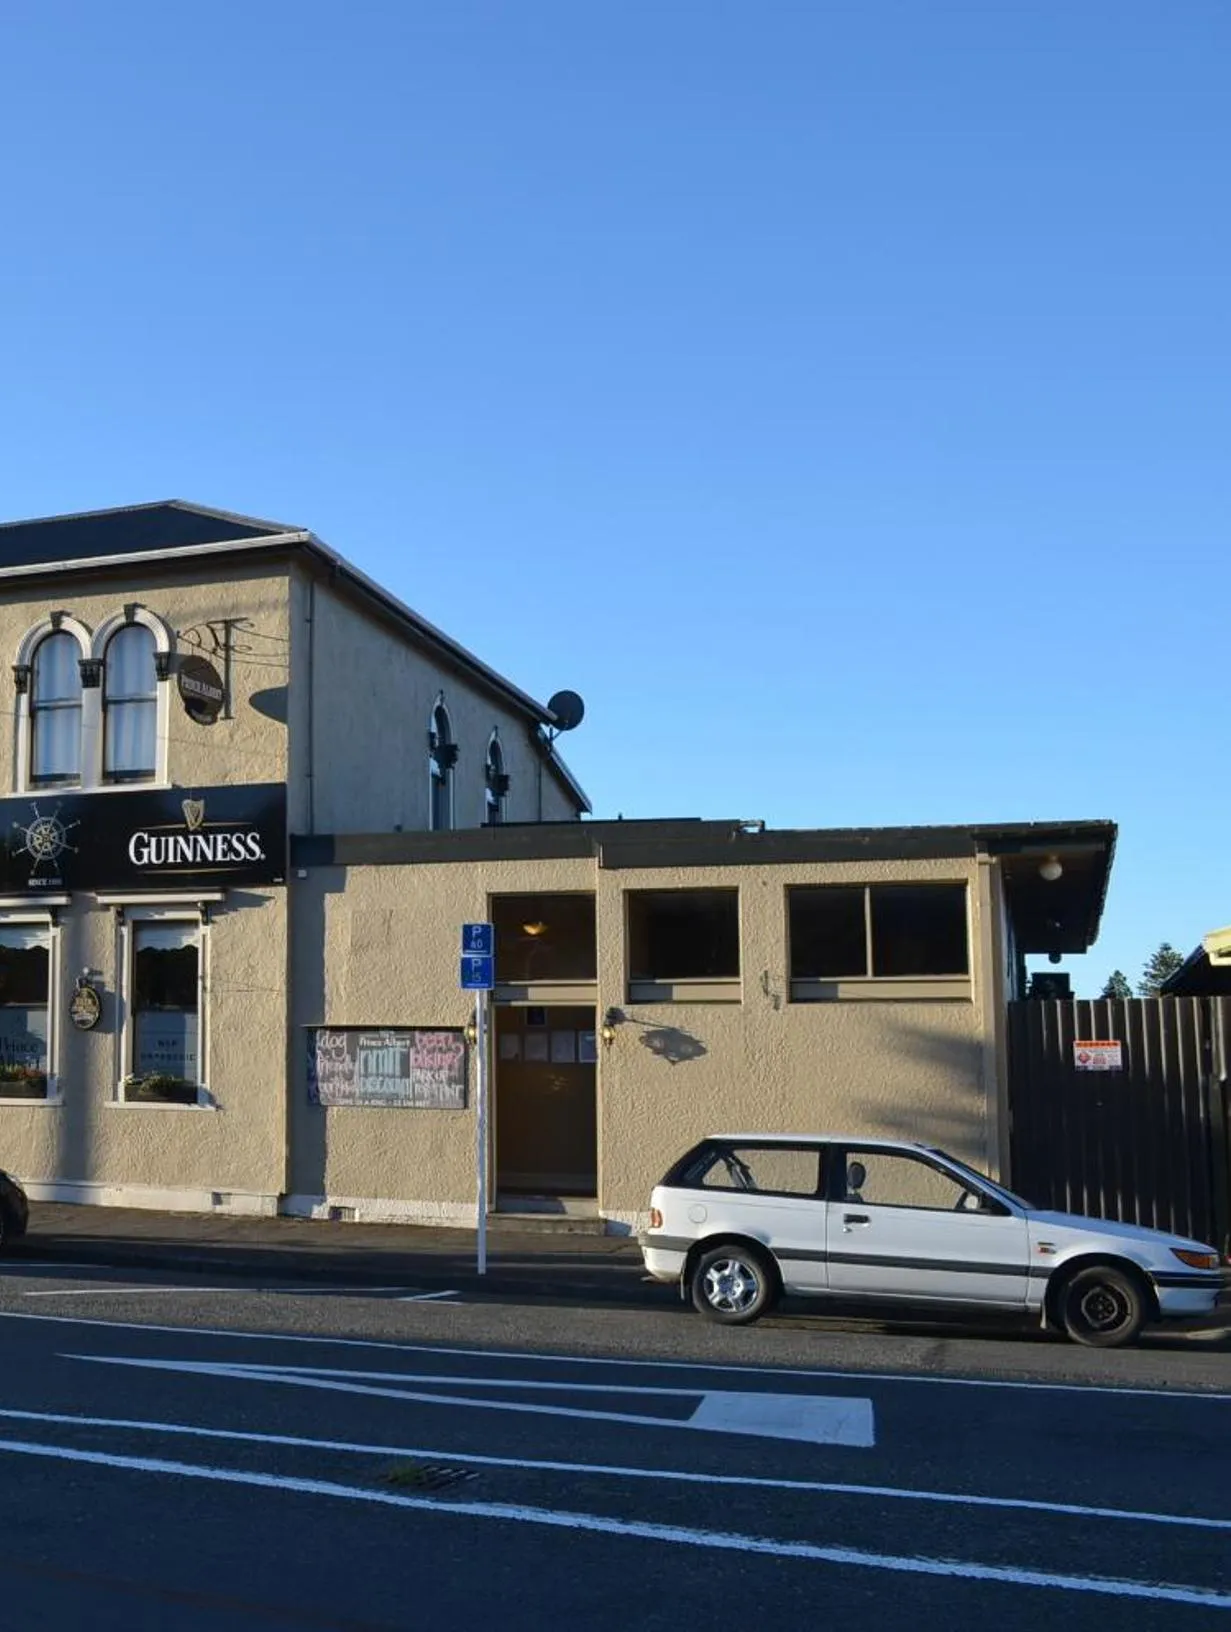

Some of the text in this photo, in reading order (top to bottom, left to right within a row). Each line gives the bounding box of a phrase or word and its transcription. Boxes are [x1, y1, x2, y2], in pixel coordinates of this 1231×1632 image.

[129, 831, 265, 865] GUINNESS
[471, 925, 482, 937] P
[471, 958, 482, 972] P
